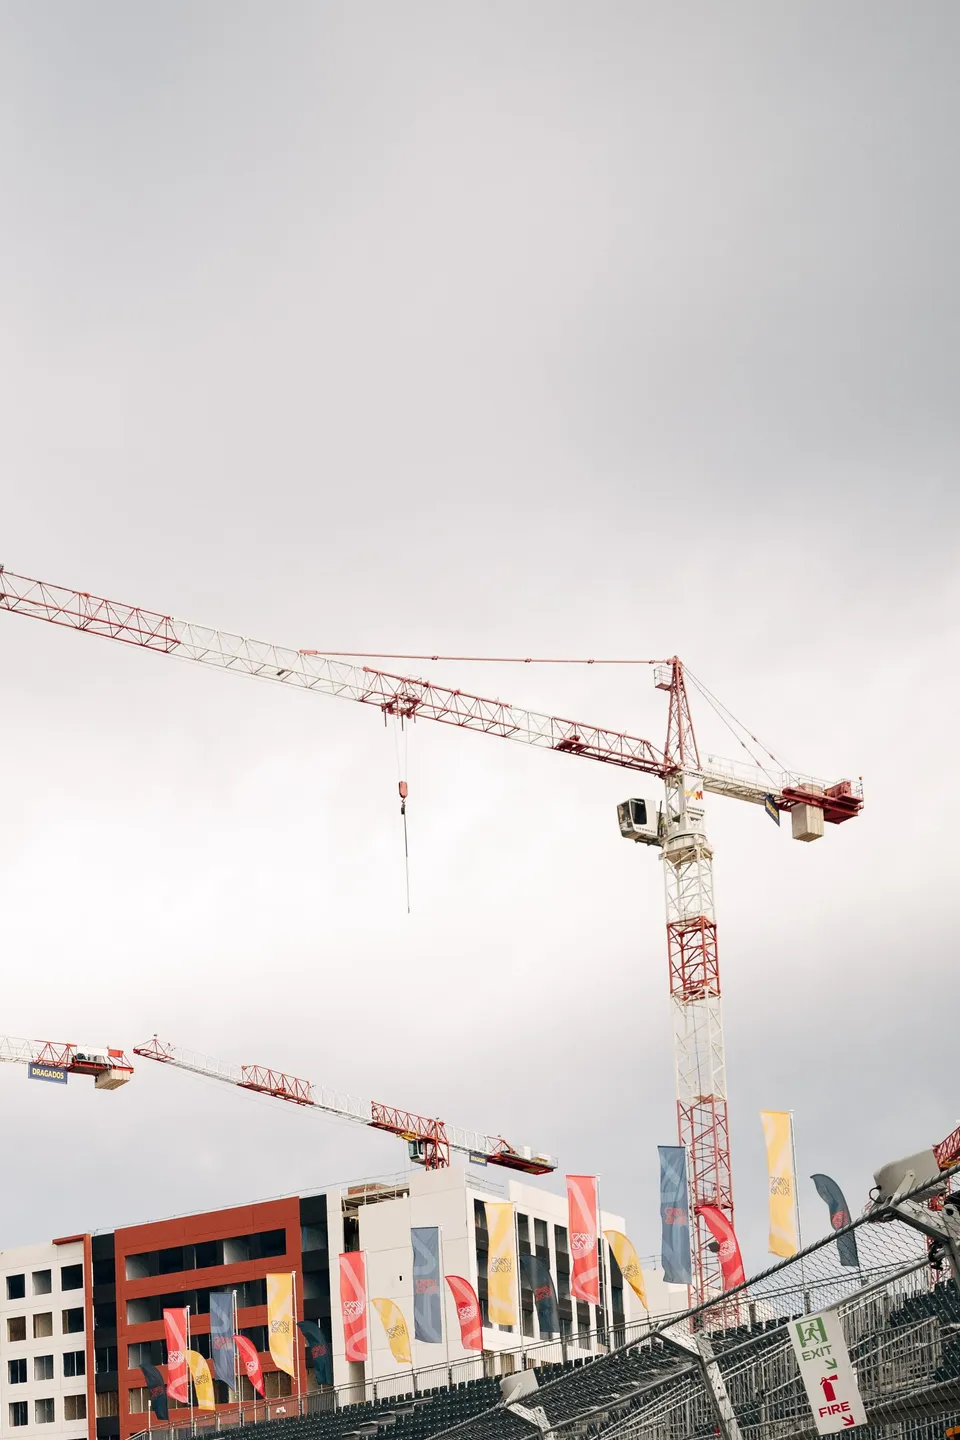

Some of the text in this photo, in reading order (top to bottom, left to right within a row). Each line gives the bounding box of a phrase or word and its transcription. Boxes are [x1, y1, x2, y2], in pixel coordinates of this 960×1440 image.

[32, 1067, 65, 1080] DRAGADOS
[801, 1345, 832, 1362] EXIT
[818, 1401, 850, 1417] FIRE
